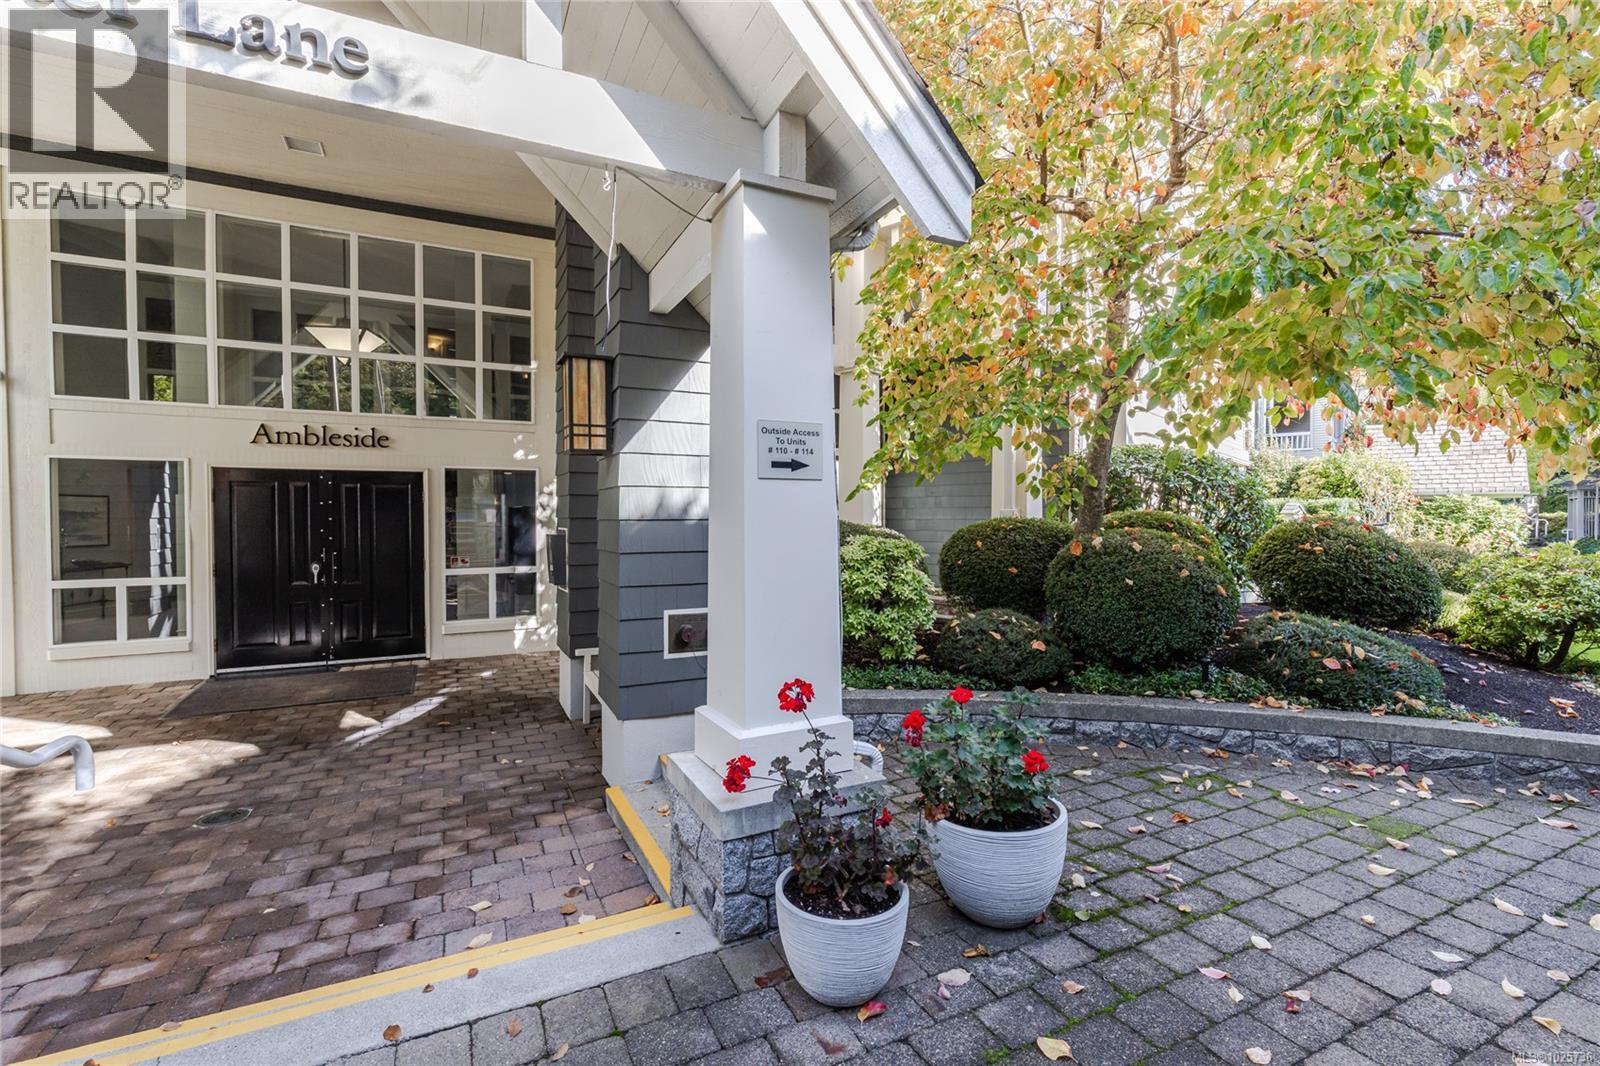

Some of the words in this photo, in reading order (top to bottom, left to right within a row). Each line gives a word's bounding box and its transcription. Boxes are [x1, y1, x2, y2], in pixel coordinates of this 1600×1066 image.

[172, 0, 370, 79] Lane
[250, 423, 391, 449] Ambleside
[761, 426, 791, 436] Outside
[792, 428, 820, 437] Access
[776, 437, 785, 445] To
[776, 447, 788, 455] 110
